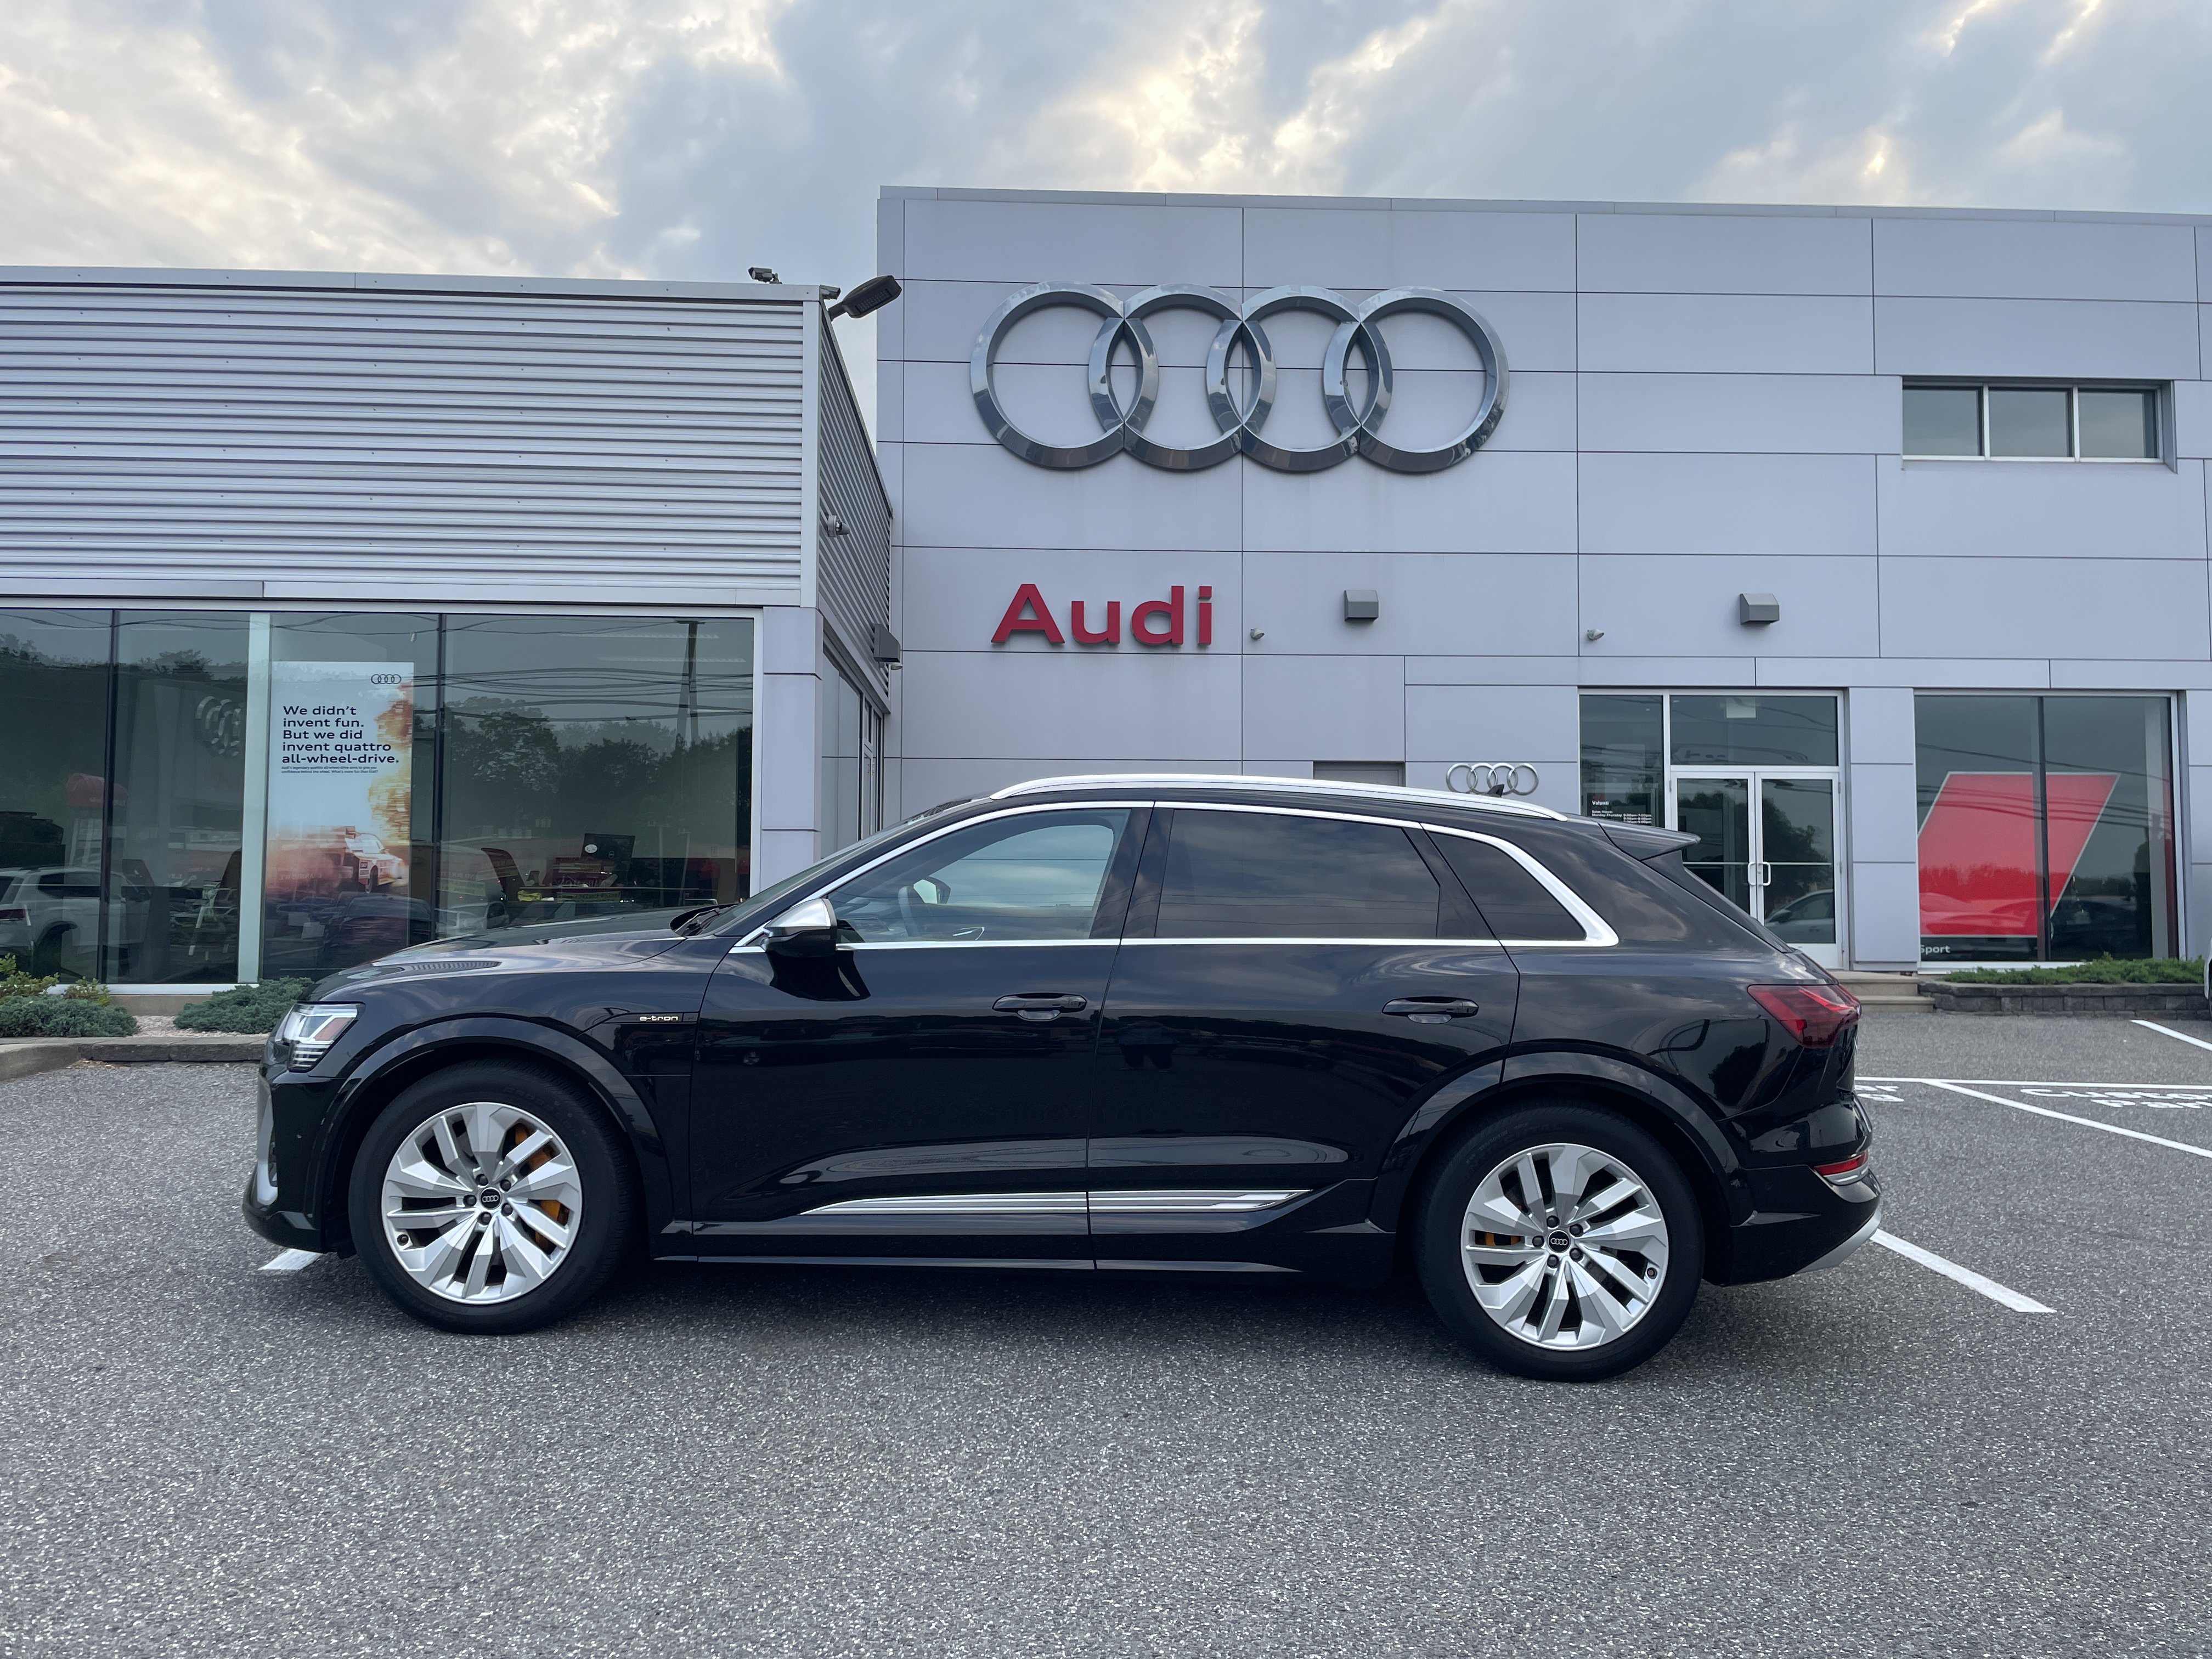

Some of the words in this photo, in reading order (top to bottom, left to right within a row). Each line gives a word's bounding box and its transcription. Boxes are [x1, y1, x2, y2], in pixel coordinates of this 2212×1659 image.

[991, 583, 1212, 645] Audi
[283, 706, 308, 715] We
[283, 718, 330, 727] invent
[335, 718, 364, 727] fun.
[283, 730, 309, 739] But
[340, 730, 363, 739] did
[283, 742, 330, 751] invent
[334, 743, 391, 753] quattro
[282, 754, 399, 763] all-wheel-drive.
